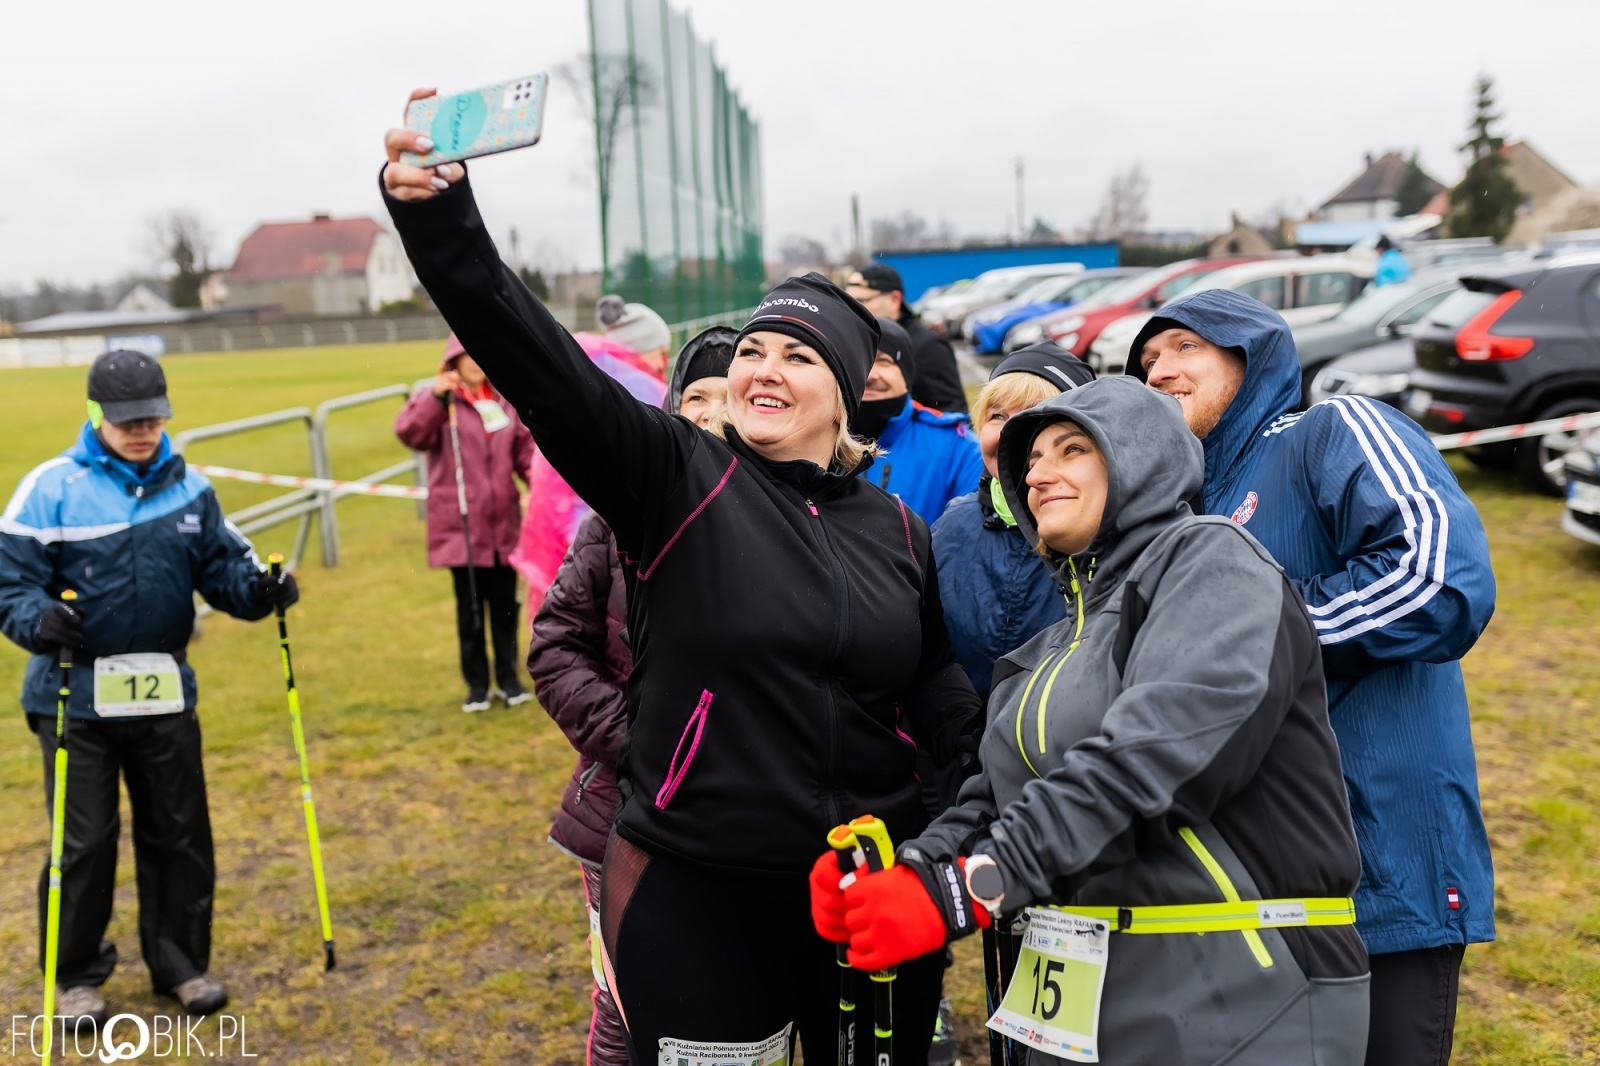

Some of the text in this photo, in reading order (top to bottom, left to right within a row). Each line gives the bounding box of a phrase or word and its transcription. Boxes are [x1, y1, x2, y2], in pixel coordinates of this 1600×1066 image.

[124, 675, 160, 700] 12
[945, 864, 966, 928] GABEL
[1032, 955, 1065, 1021] 15
[676, 1049, 698, 1057] Kuźnia
[699, 1051, 737, 1059] Raciborska,
[677, 1042, 712, 1051] Kuźniański
